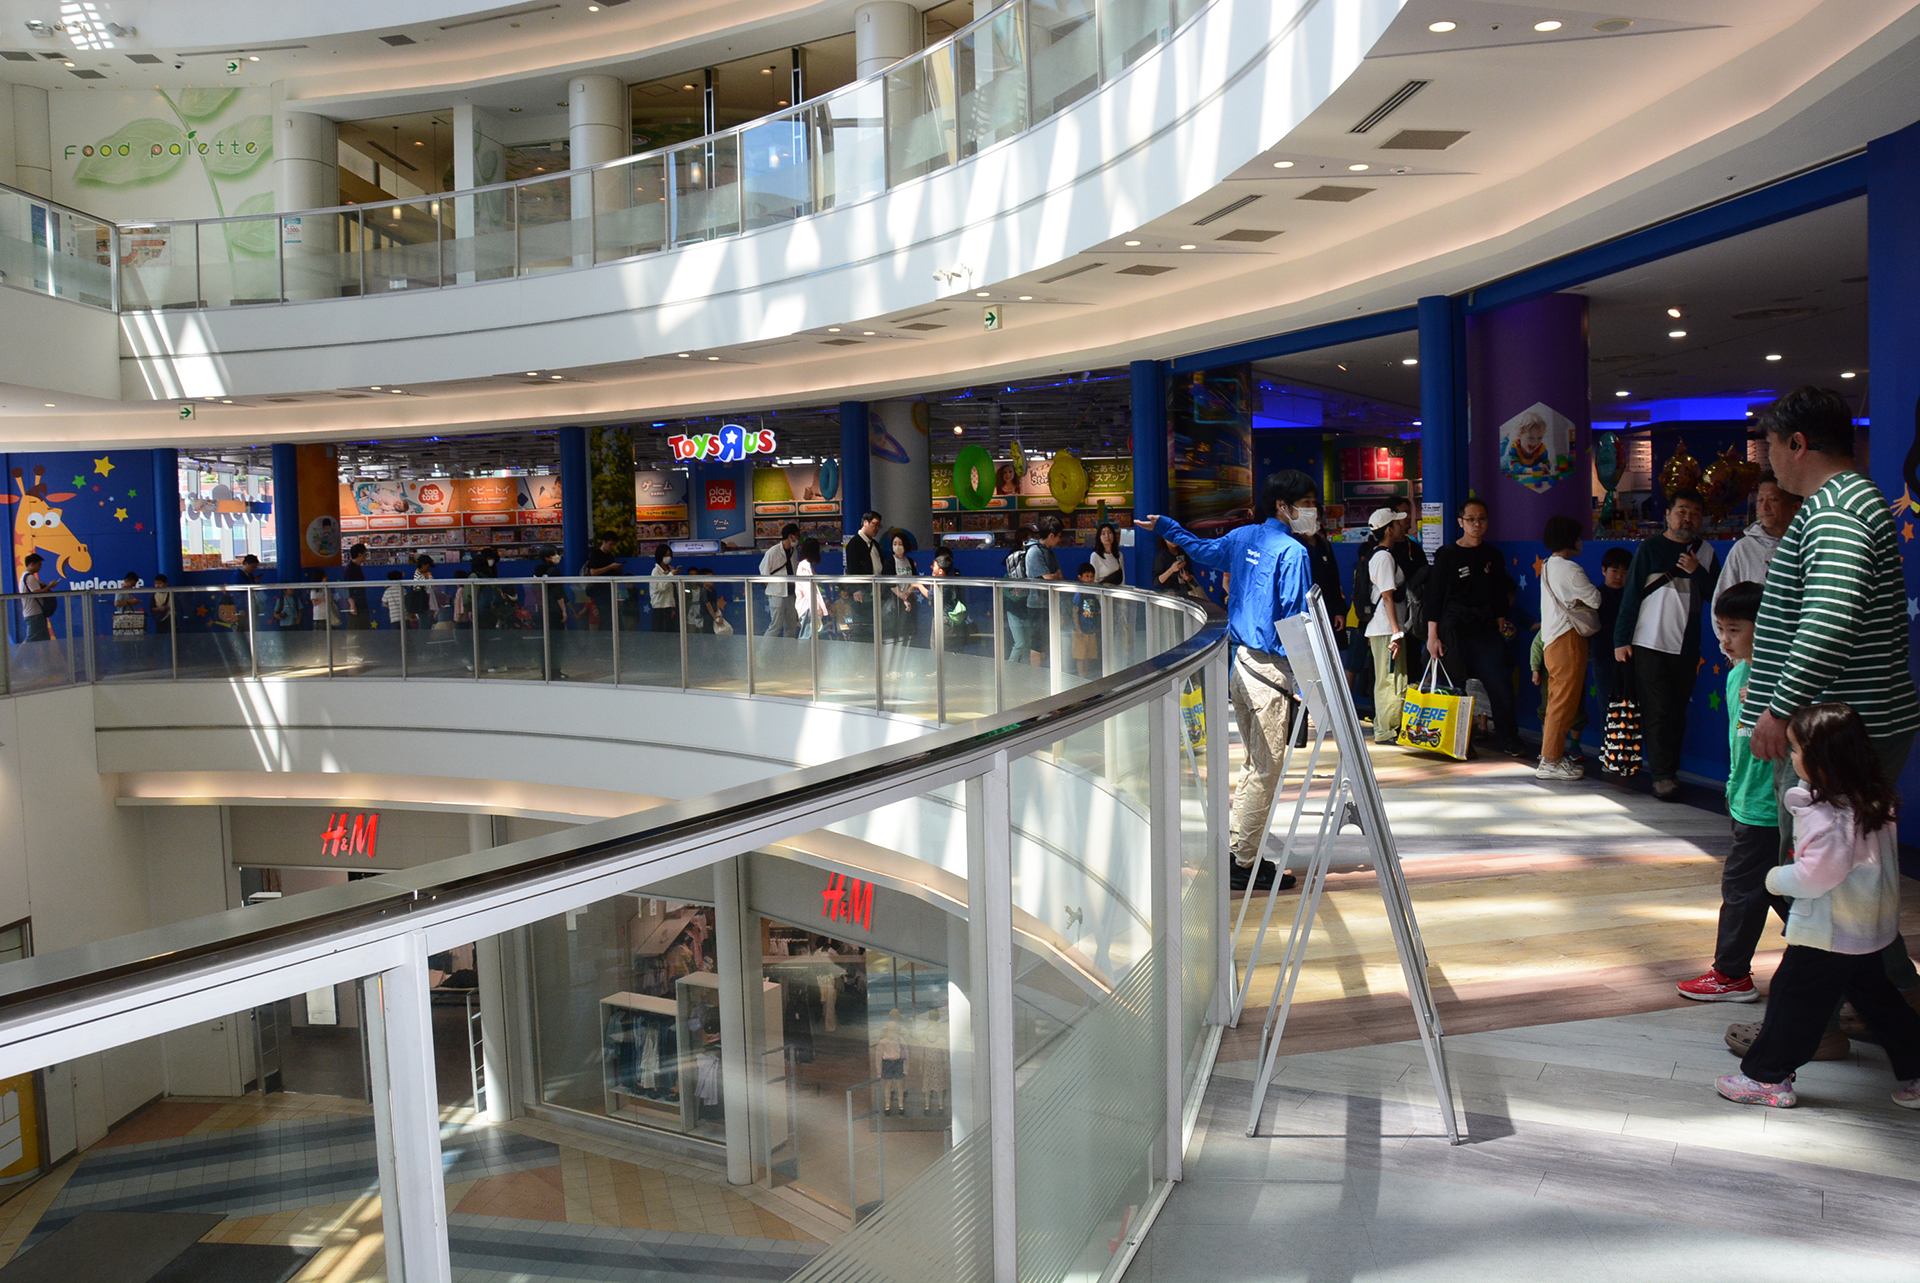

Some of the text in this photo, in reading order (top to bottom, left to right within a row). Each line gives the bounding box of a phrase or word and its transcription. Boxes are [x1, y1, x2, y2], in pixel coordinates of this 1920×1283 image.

[65, 140, 258, 160] Food palette
[642, 480, 673, 491] ゲーム
[421, 493, 440, 501] tots
[423, 488, 440, 496] top
[709, 486, 732, 497] play
[710, 496, 731, 505] pop
[320, 813, 378, 859] H&M
[821, 871, 874, 932] H&M
